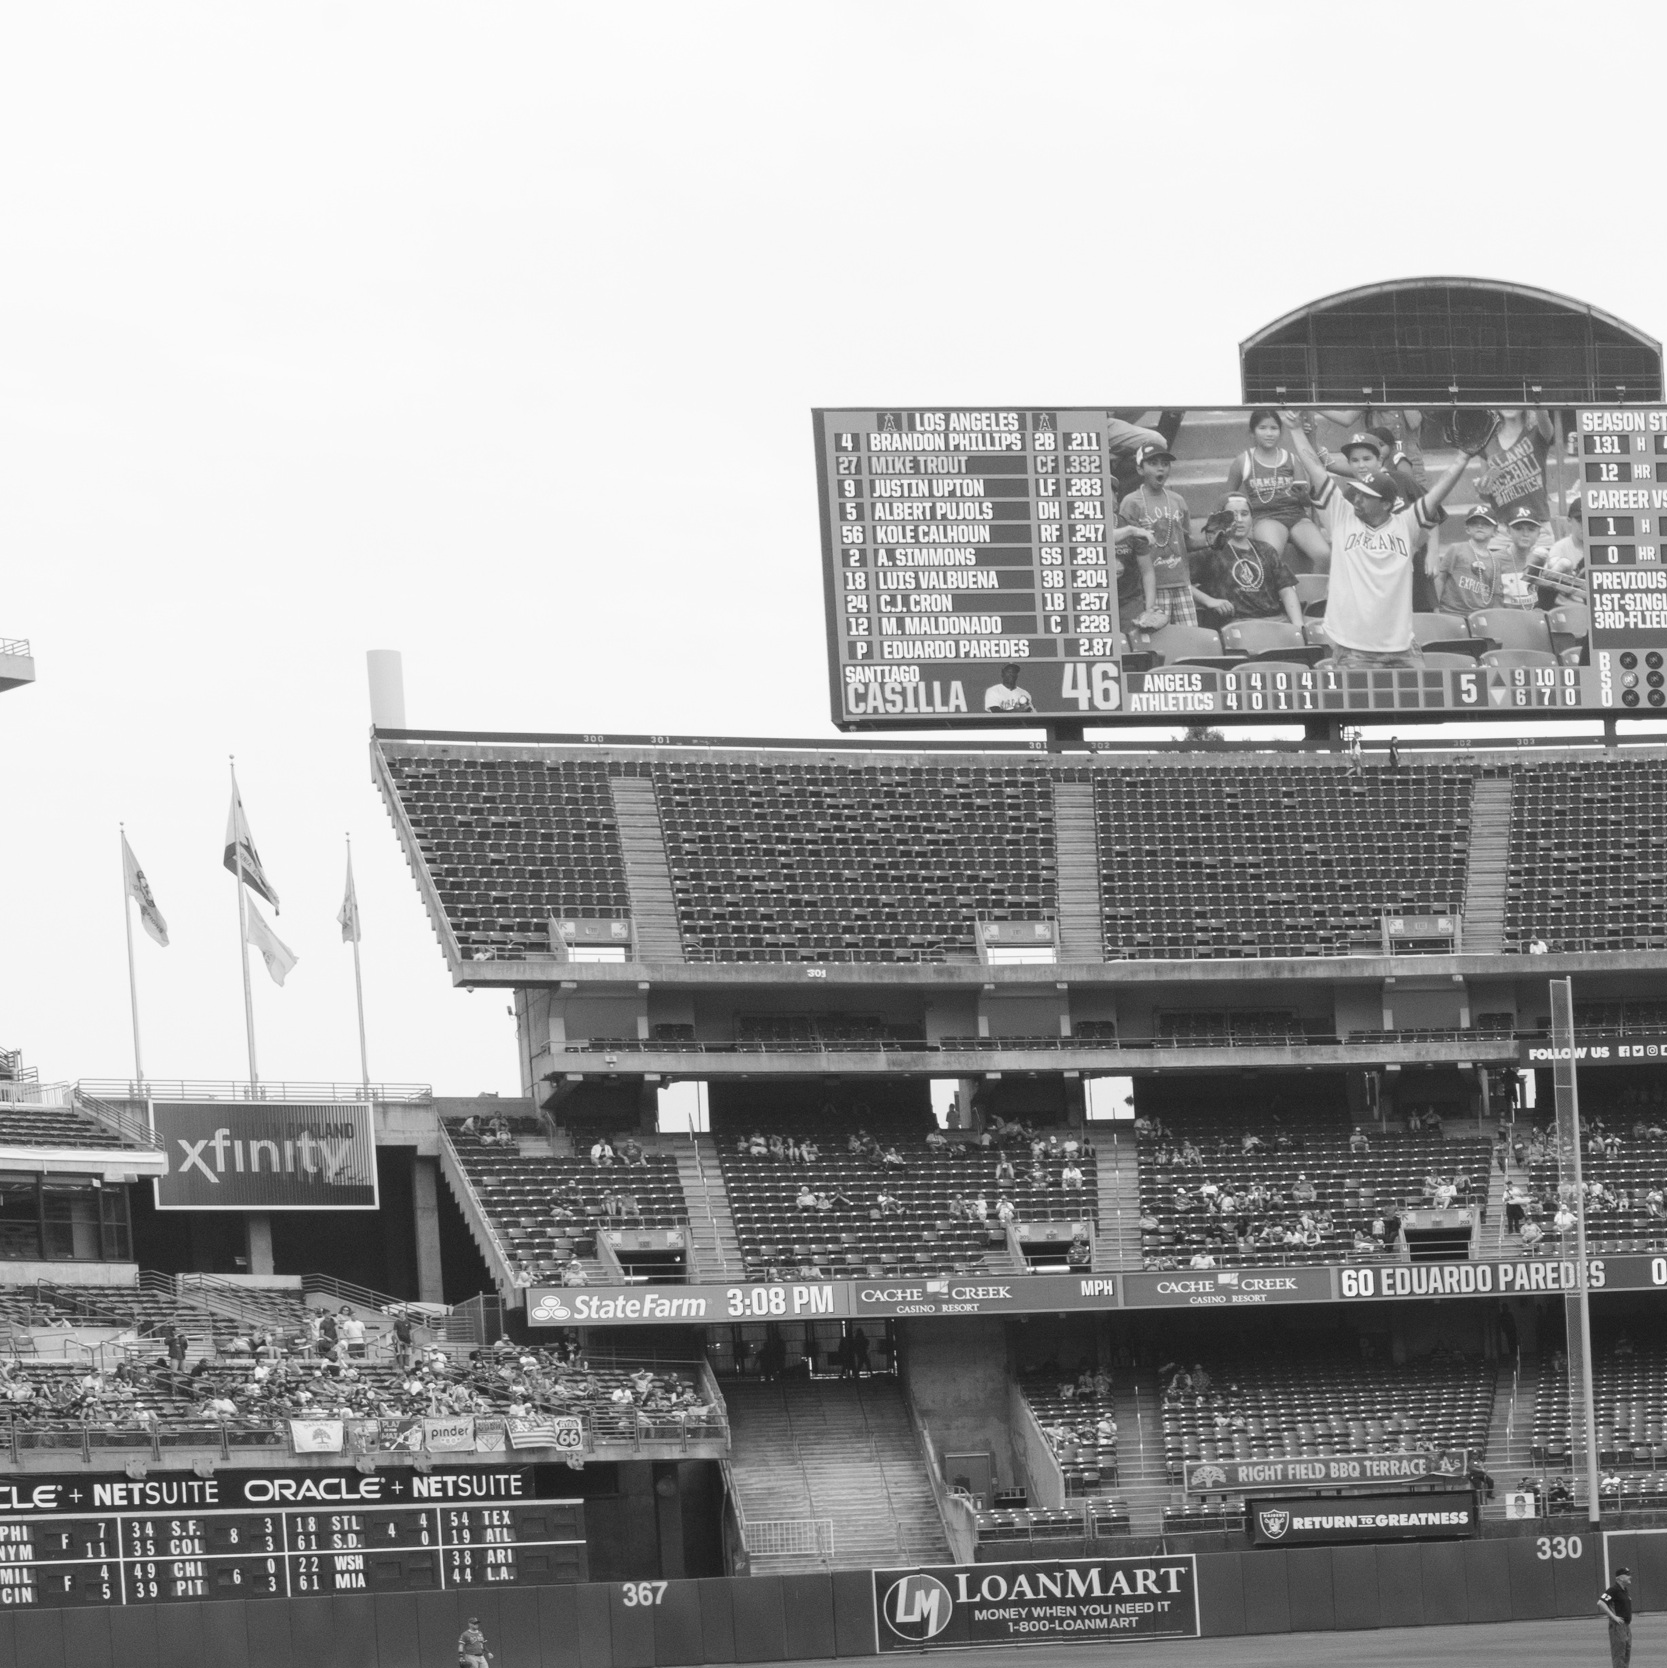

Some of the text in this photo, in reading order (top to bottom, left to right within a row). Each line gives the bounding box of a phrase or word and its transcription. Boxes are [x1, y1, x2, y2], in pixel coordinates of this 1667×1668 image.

[915, 412, 1019, 431] LOS ANGELES
[1582, 412, 1645, 431] SEASON
[870, 433, 1021, 451] BRANDON PHILLIPS
[871, 456, 968, 474] MIKE TROUT
[873, 479, 984, 497] JUSTIN UPTON
[1587, 490, 1649, 508] CAREER
[875, 502, 993, 520] ALBERT PUJOLS
[876, 525, 990, 543] KOLE CALHOUN
[877, 548, 976, 566] A. SIMMONS
[879, 571, 999, 589] LUIS VALBUENA
[1593, 571, 1667, 589] PREVIOUS
[880, 594, 952, 612] C.J. CRON
[881, 616, 1002, 635] M. MALDONADO
[883, 639, 1029, 659] EDUARDO PAREDES
[845, 666, 920, 683] SANTIAGO
[1144, 674, 1202, 692] ANGELS
[847, 662, 1120, 714] CASILLA 46
[1131, 692, 1214, 712] ATHLETICS
[1529, 1047, 1610, 1060] FOLLOW US
[177, 1127, 353, 1184] xfinity
[1081, 1280, 1113, 1296] MPH
[1342, 1269, 1374, 1297] 60
[1381, 1265, 1492, 1295] EDUARDO
[727, 1287, 786, 1316] 3:08
[793, 1285, 833, 1313] PM
[431, 1425, 469, 1439] pinder
[1238, 1459, 1426, 1482] RIGHT FIELD BBQ TERRACE
[93, 1475, 522, 1506] NETSUITE ORACLE NETSUITE
[171, 1510, 511, 1536] S.F. STL TEX
[1293, 1515, 1357, 1529] RETURN
[1375, 1511, 1468, 1527] GREATNESS
[170, 1528, 511, 1555] COL S.D. ATL
[1537, 1536, 1582, 1560] 330
[174, 1549, 512, 1577] CHI WSH ARI
[177, 1566, 514, 1596] PIT MIA L.A.
[623, 1581, 668, 1607] 367
[975, 1601, 1171, 1621] MONEY WHEN YOU NEED IT
[1008, 1617, 1139, 1633] 1-800-LOANMART
